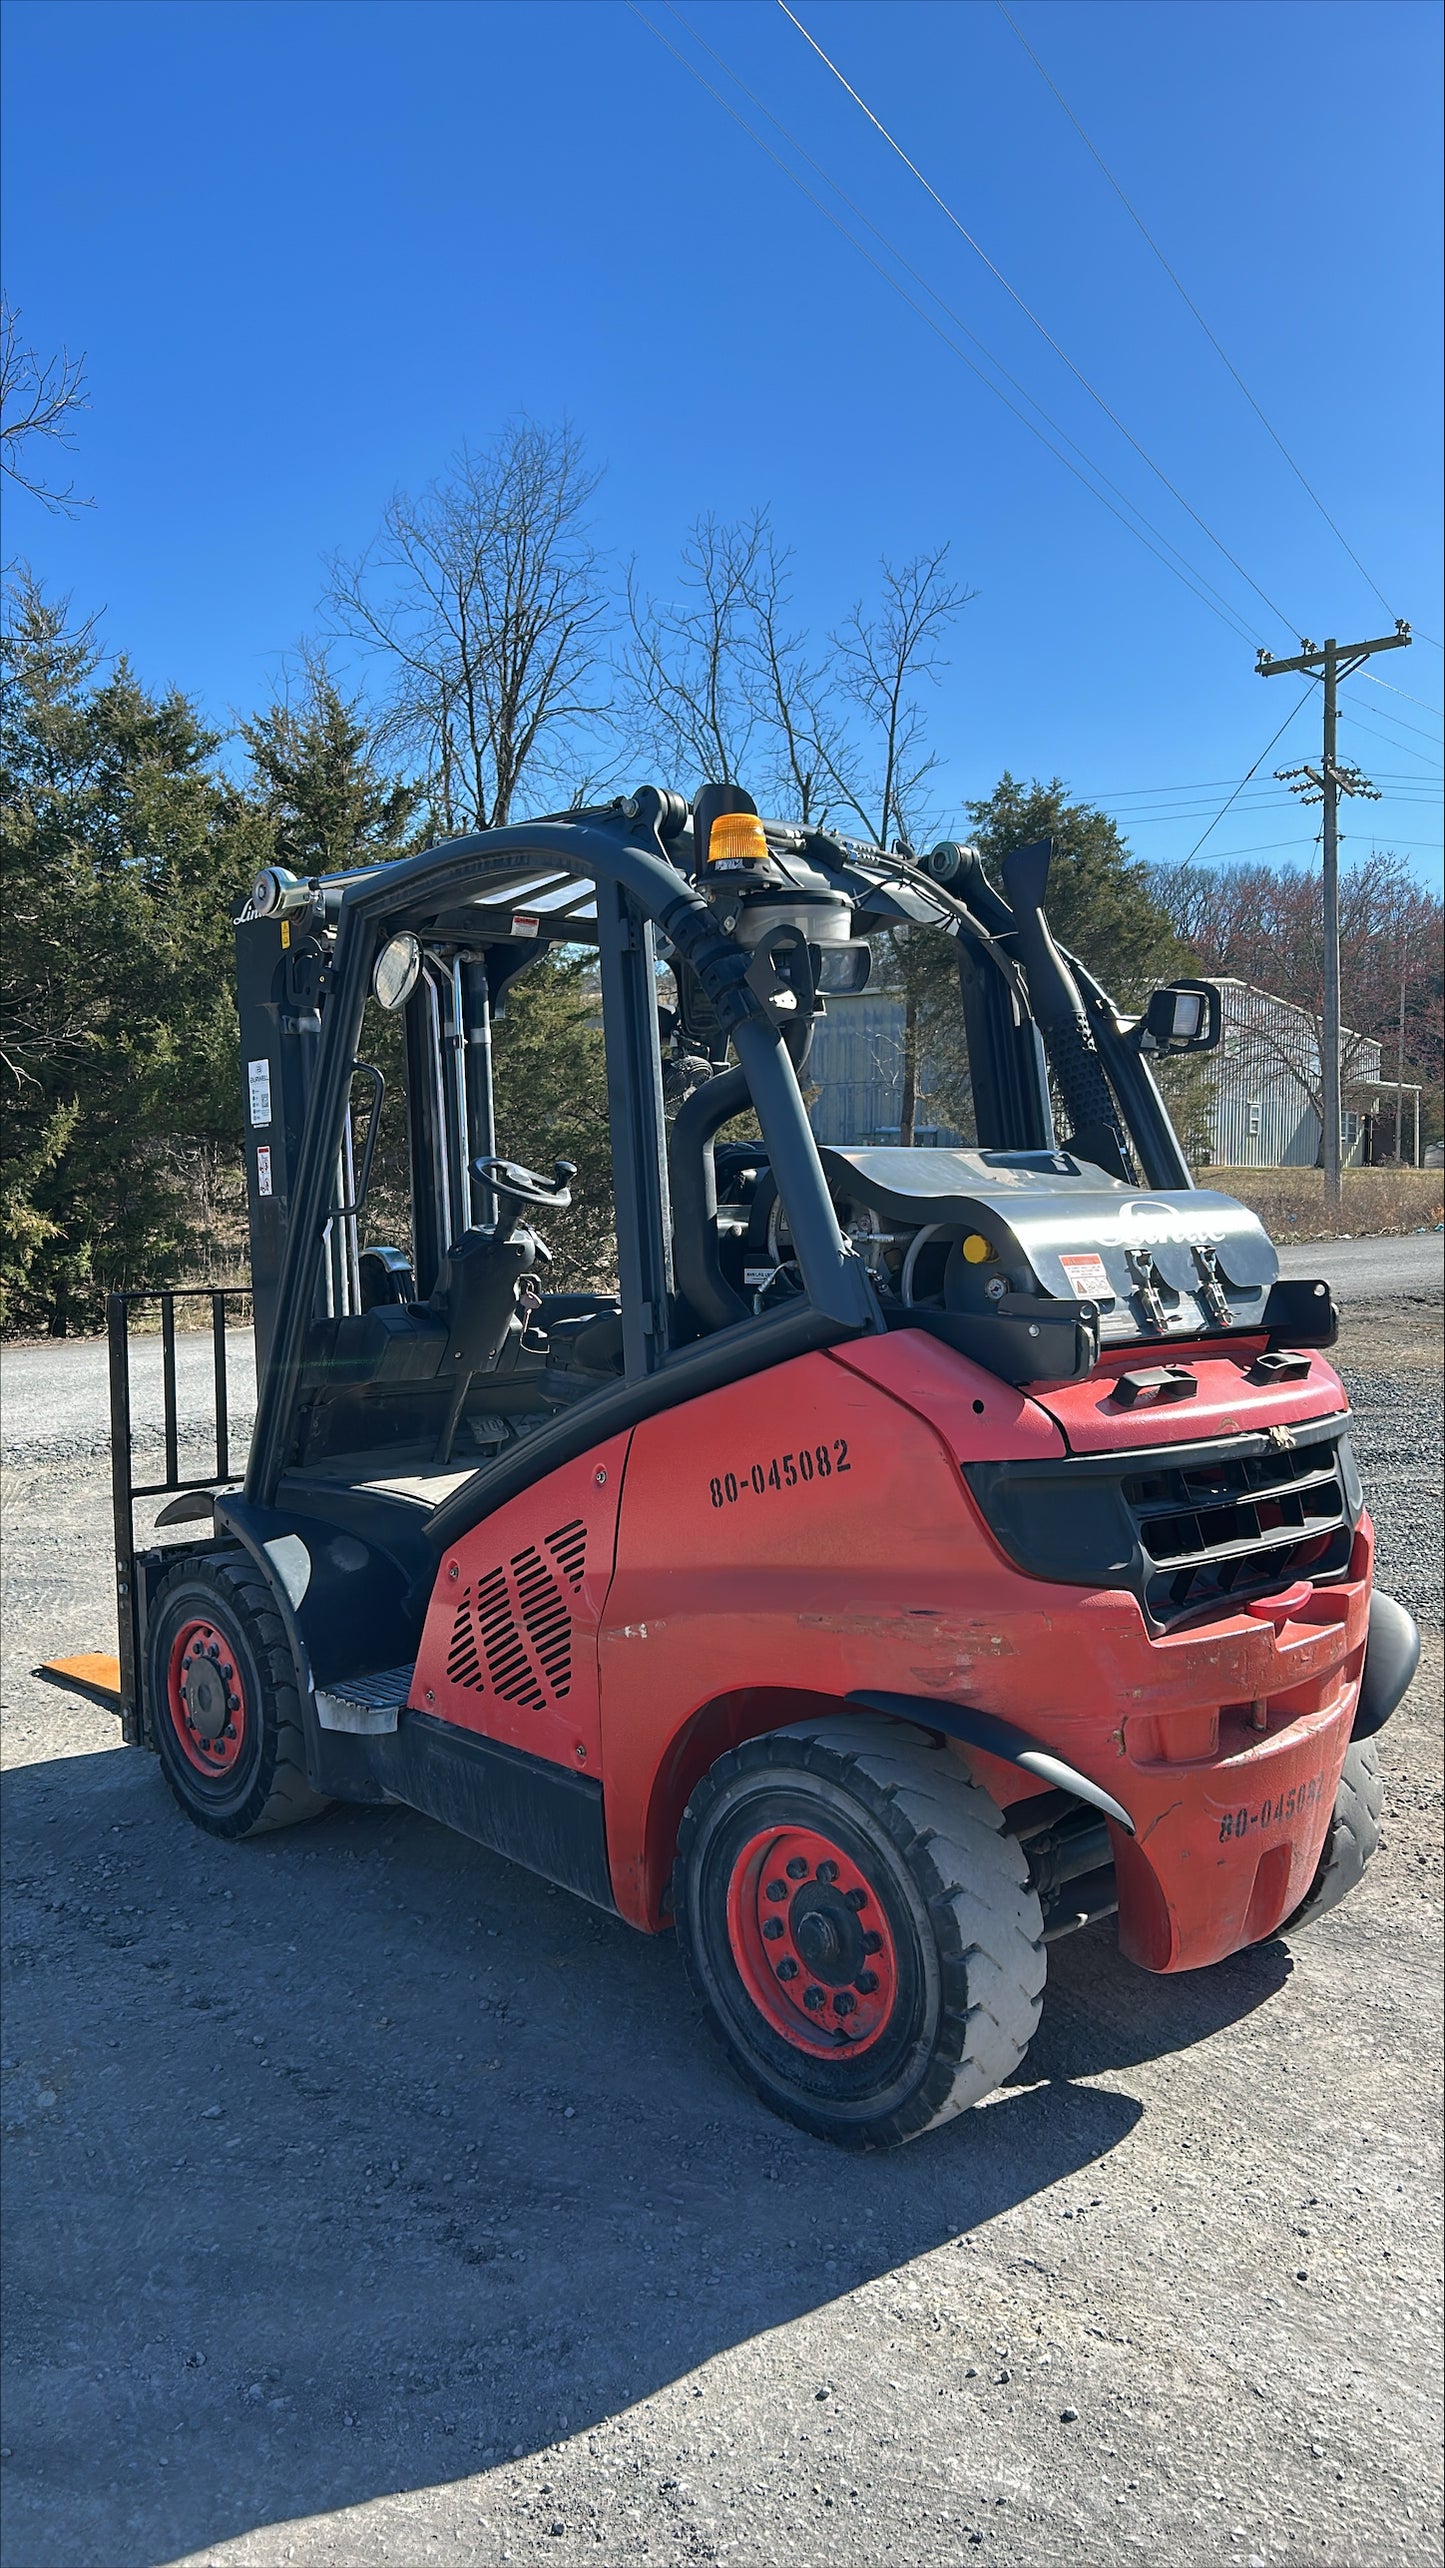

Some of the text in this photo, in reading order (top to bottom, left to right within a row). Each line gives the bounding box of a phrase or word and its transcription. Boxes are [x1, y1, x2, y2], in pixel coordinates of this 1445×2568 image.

[233, 897, 266, 926] Lin
[709, 1438, 851, 1508] 80-045082
[1218, 1771, 1325, 1843] 80-045082
